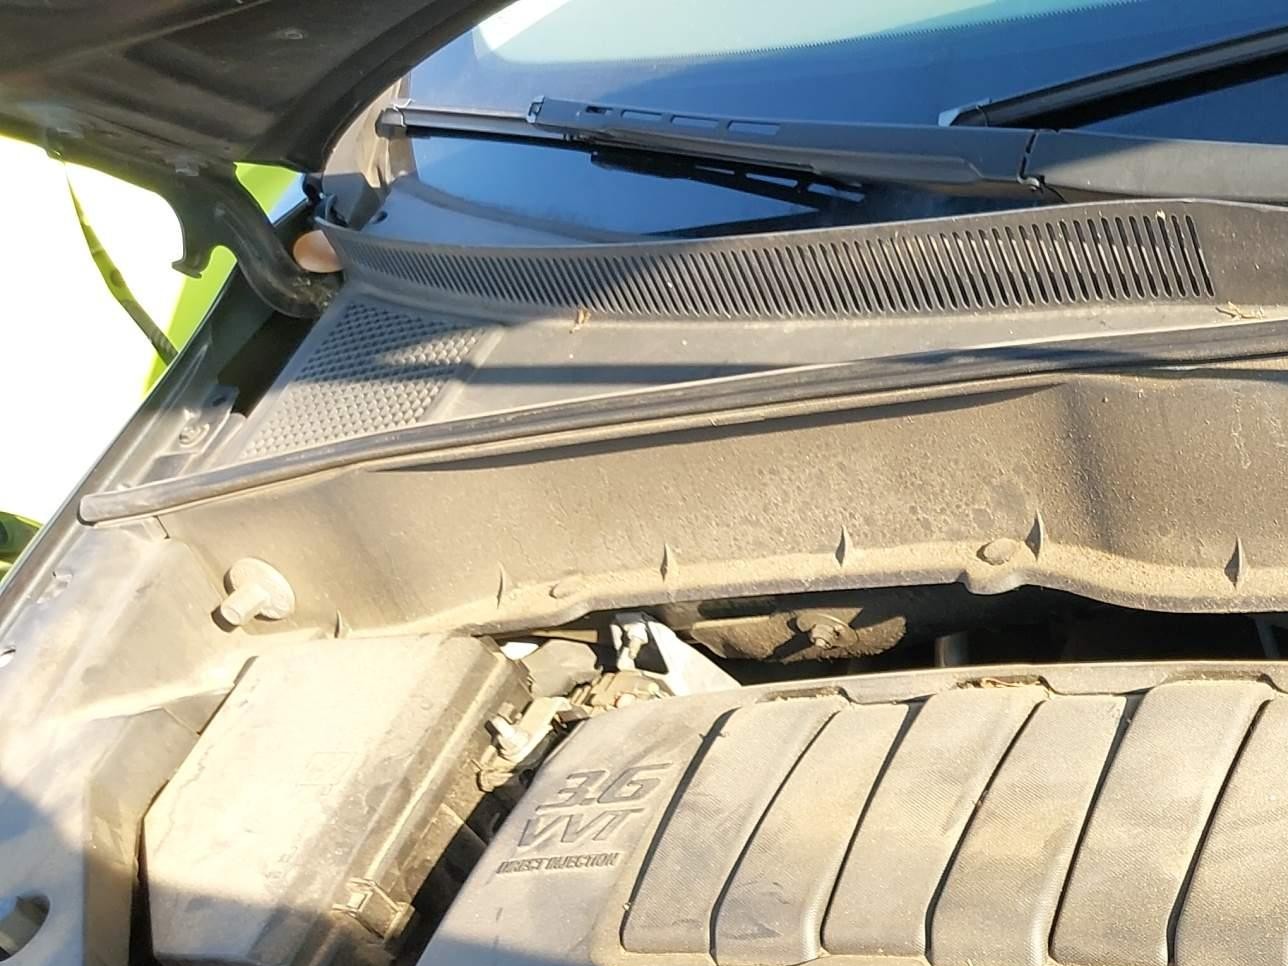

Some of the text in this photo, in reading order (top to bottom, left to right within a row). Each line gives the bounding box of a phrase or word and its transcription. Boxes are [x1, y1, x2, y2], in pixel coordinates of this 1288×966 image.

[517, 808, 646, 848] VVT
[495, 852, 620, 874] DIRECT INJECTION
